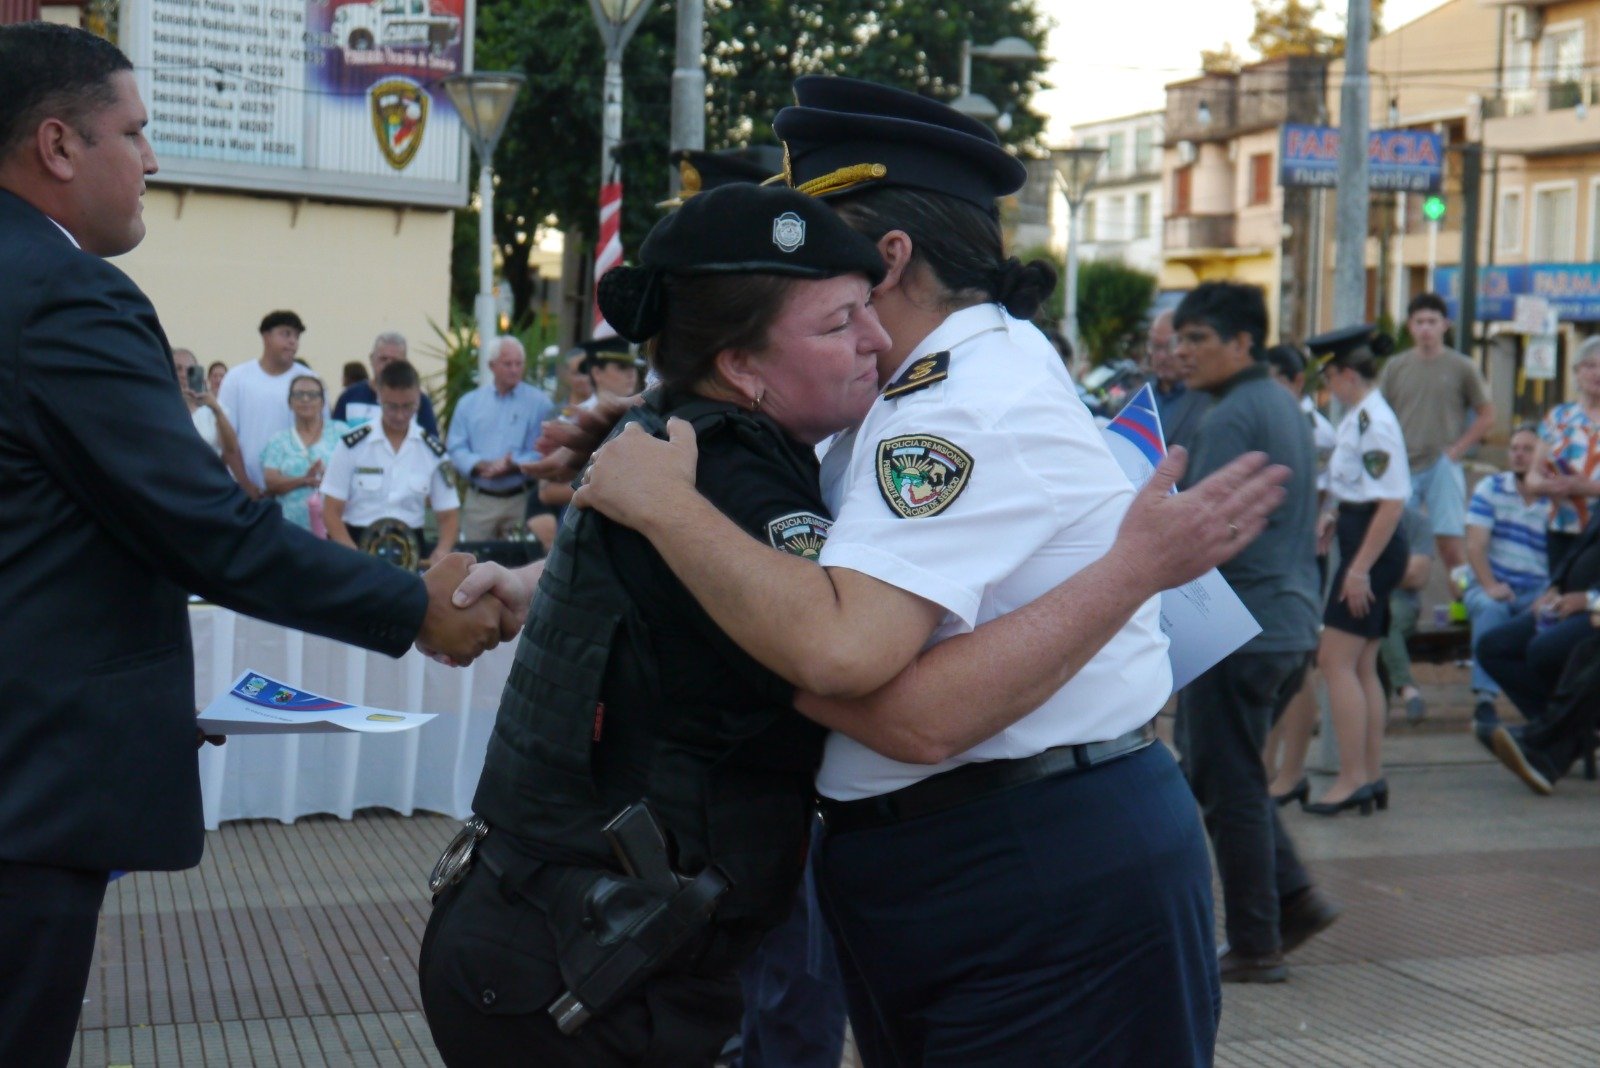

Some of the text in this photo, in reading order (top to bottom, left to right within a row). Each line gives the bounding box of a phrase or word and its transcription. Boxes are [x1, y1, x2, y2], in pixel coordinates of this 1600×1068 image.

[1287, 129, 1435, 164] FARACIA
[1367, 169, 1430, 190] entral
[885, 439, 966, 469] POLICIA DE MISIONES
[772, 517, 803, 534] POLICIA
